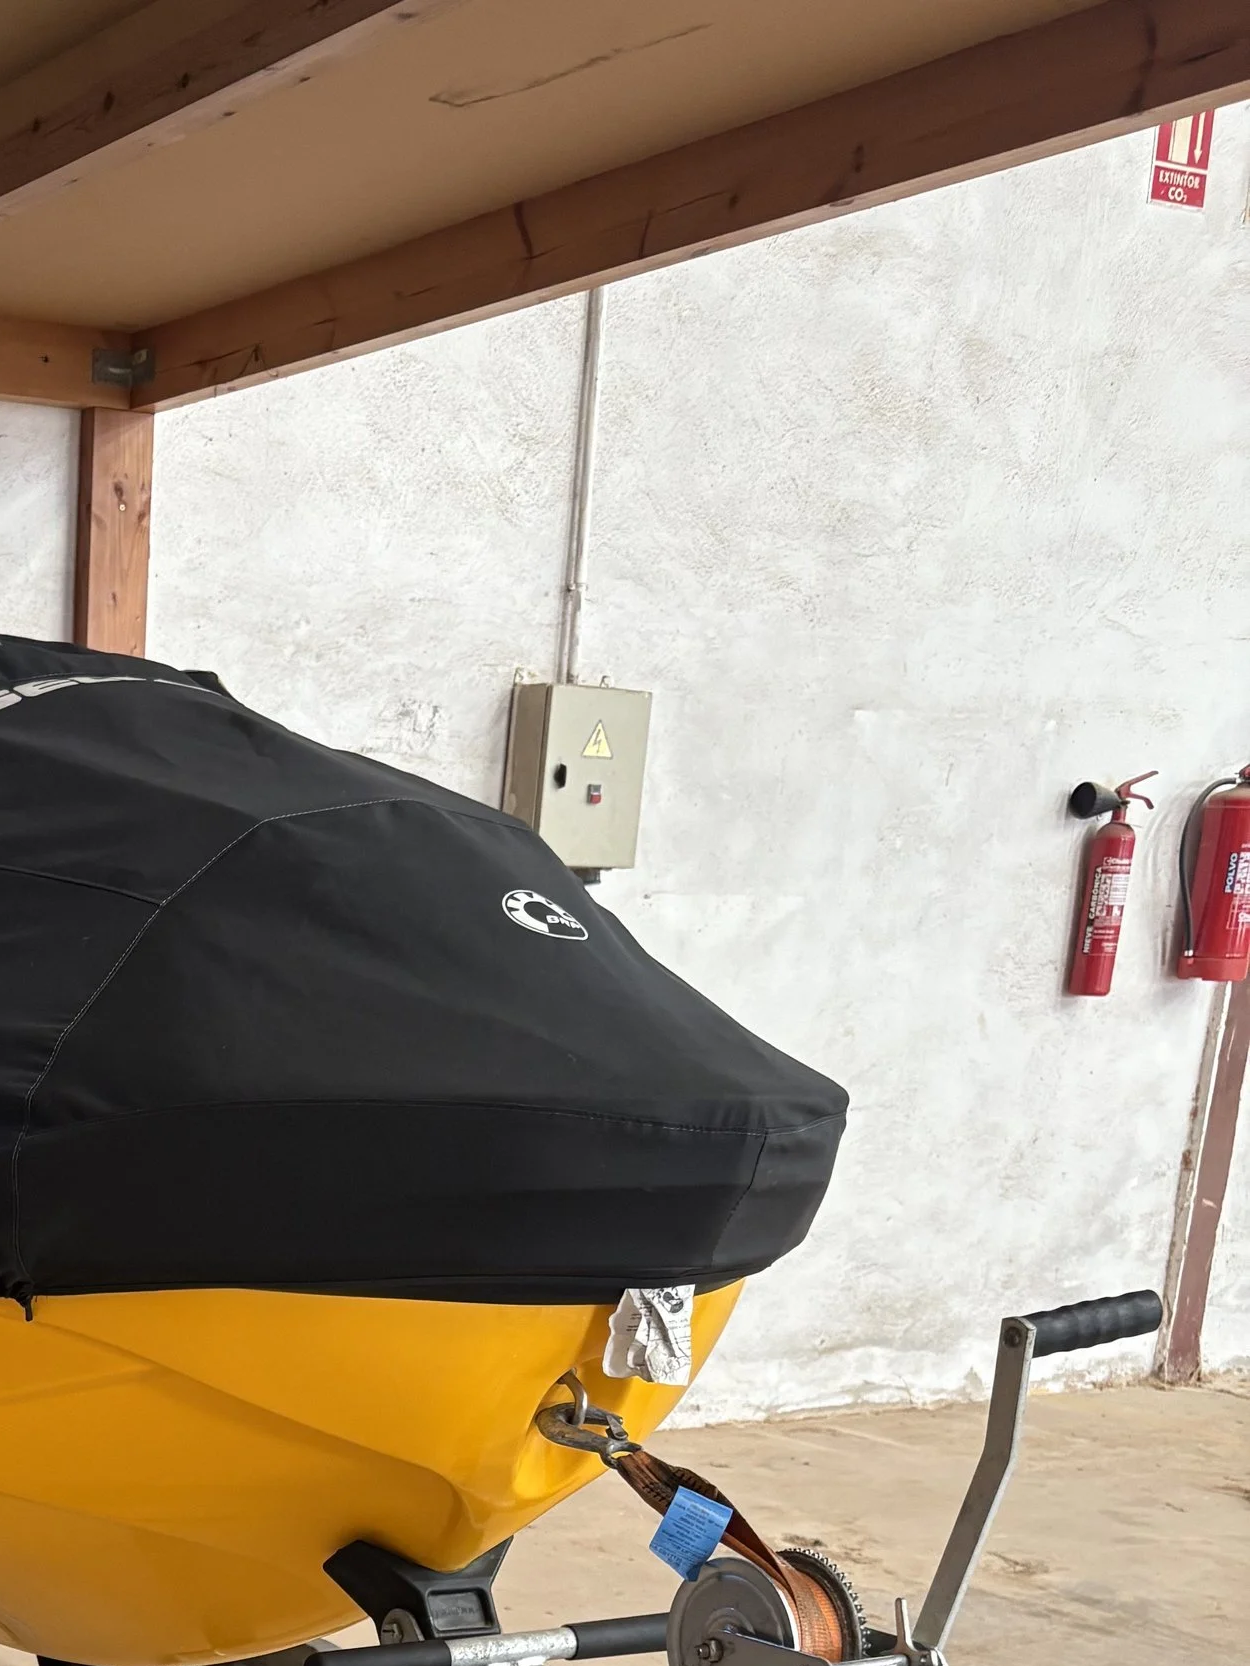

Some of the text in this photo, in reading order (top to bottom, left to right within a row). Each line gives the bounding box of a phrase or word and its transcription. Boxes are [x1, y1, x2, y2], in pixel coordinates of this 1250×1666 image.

[1158, 170, 1200, 189] EXTINTOR
[1224, 852, 1238, 894] POLVO
[1083, 926, 1093, 953] NIEVE
